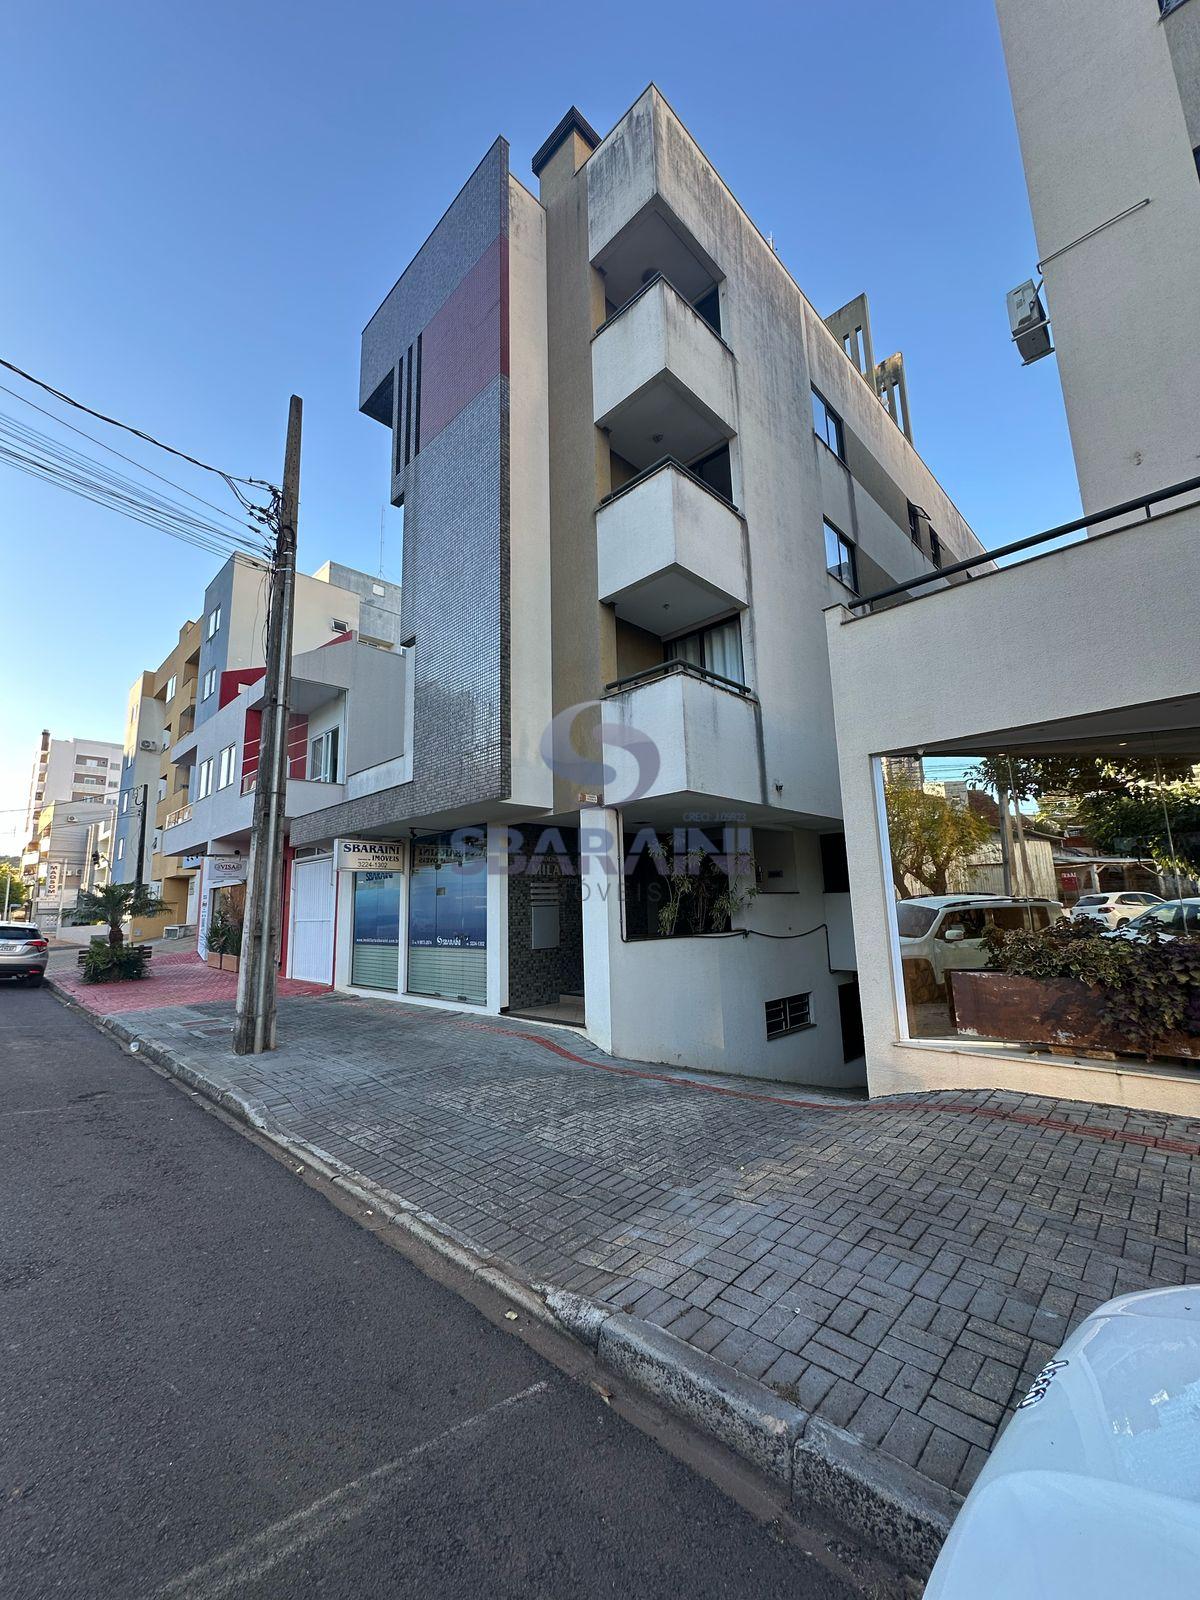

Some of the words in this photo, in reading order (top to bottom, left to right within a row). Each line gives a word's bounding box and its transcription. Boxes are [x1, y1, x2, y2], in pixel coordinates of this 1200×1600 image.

[343, 843, 400, 854] SBARAINI
[371, 854, 399, 863] IMÓVEIS
[220, 863, 237, 871] VISA
